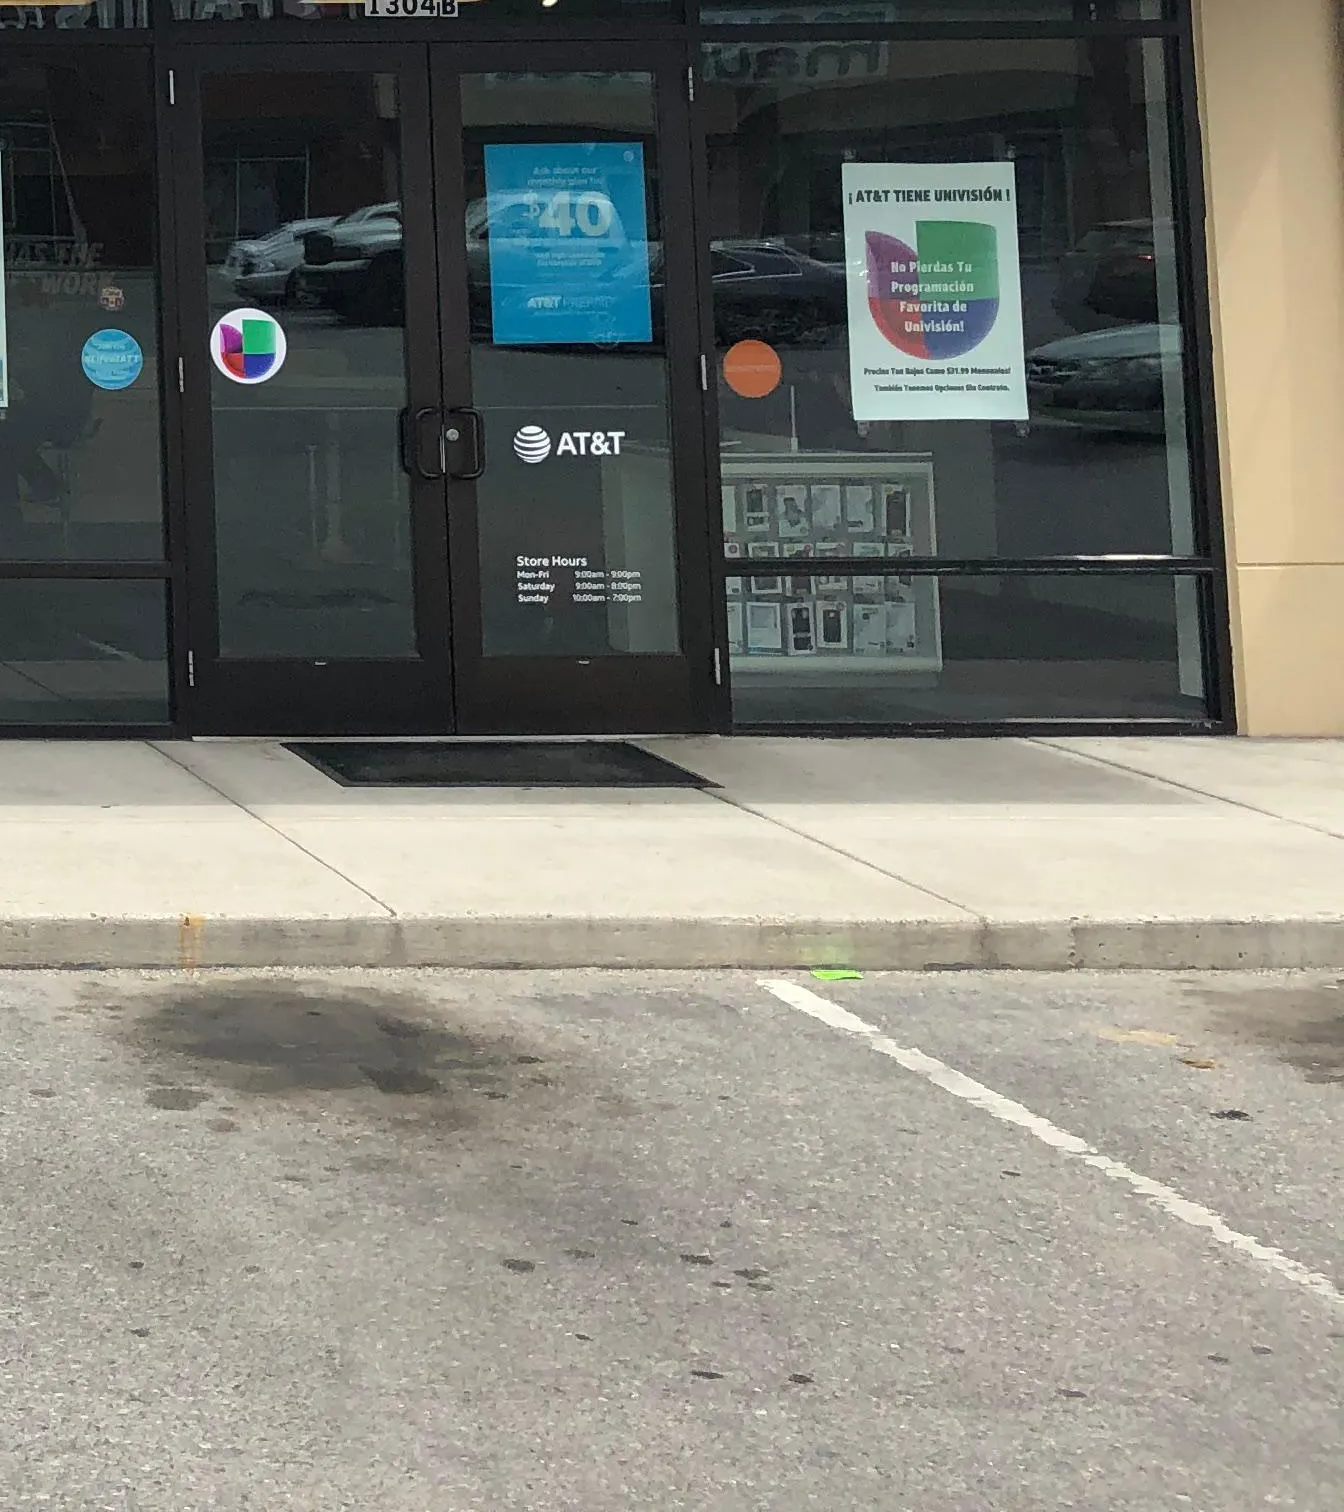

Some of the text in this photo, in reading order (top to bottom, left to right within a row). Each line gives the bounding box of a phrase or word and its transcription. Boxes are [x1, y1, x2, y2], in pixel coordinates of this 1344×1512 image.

[856, 190, 890, 202] AT&T
[893, 190, 930, 202] TIENE
[934, 186, 1002, 202] UNIVISIÓN
[891, 260, 972, 273] No Pierdas Tu
[891, 280, 974, 295] Programación
[900, 300, 967, 313] Favorita de
[904, 319, 964, 332] Univisión!
[556, 431, 625, 455] AT&T
[517, 556, 587, 567] Store Hours
[517, 570, 549, 579] Mon-Fri
[518, 582, 555, 592] Saturday
[518, 594, 549, 604] Sunday
